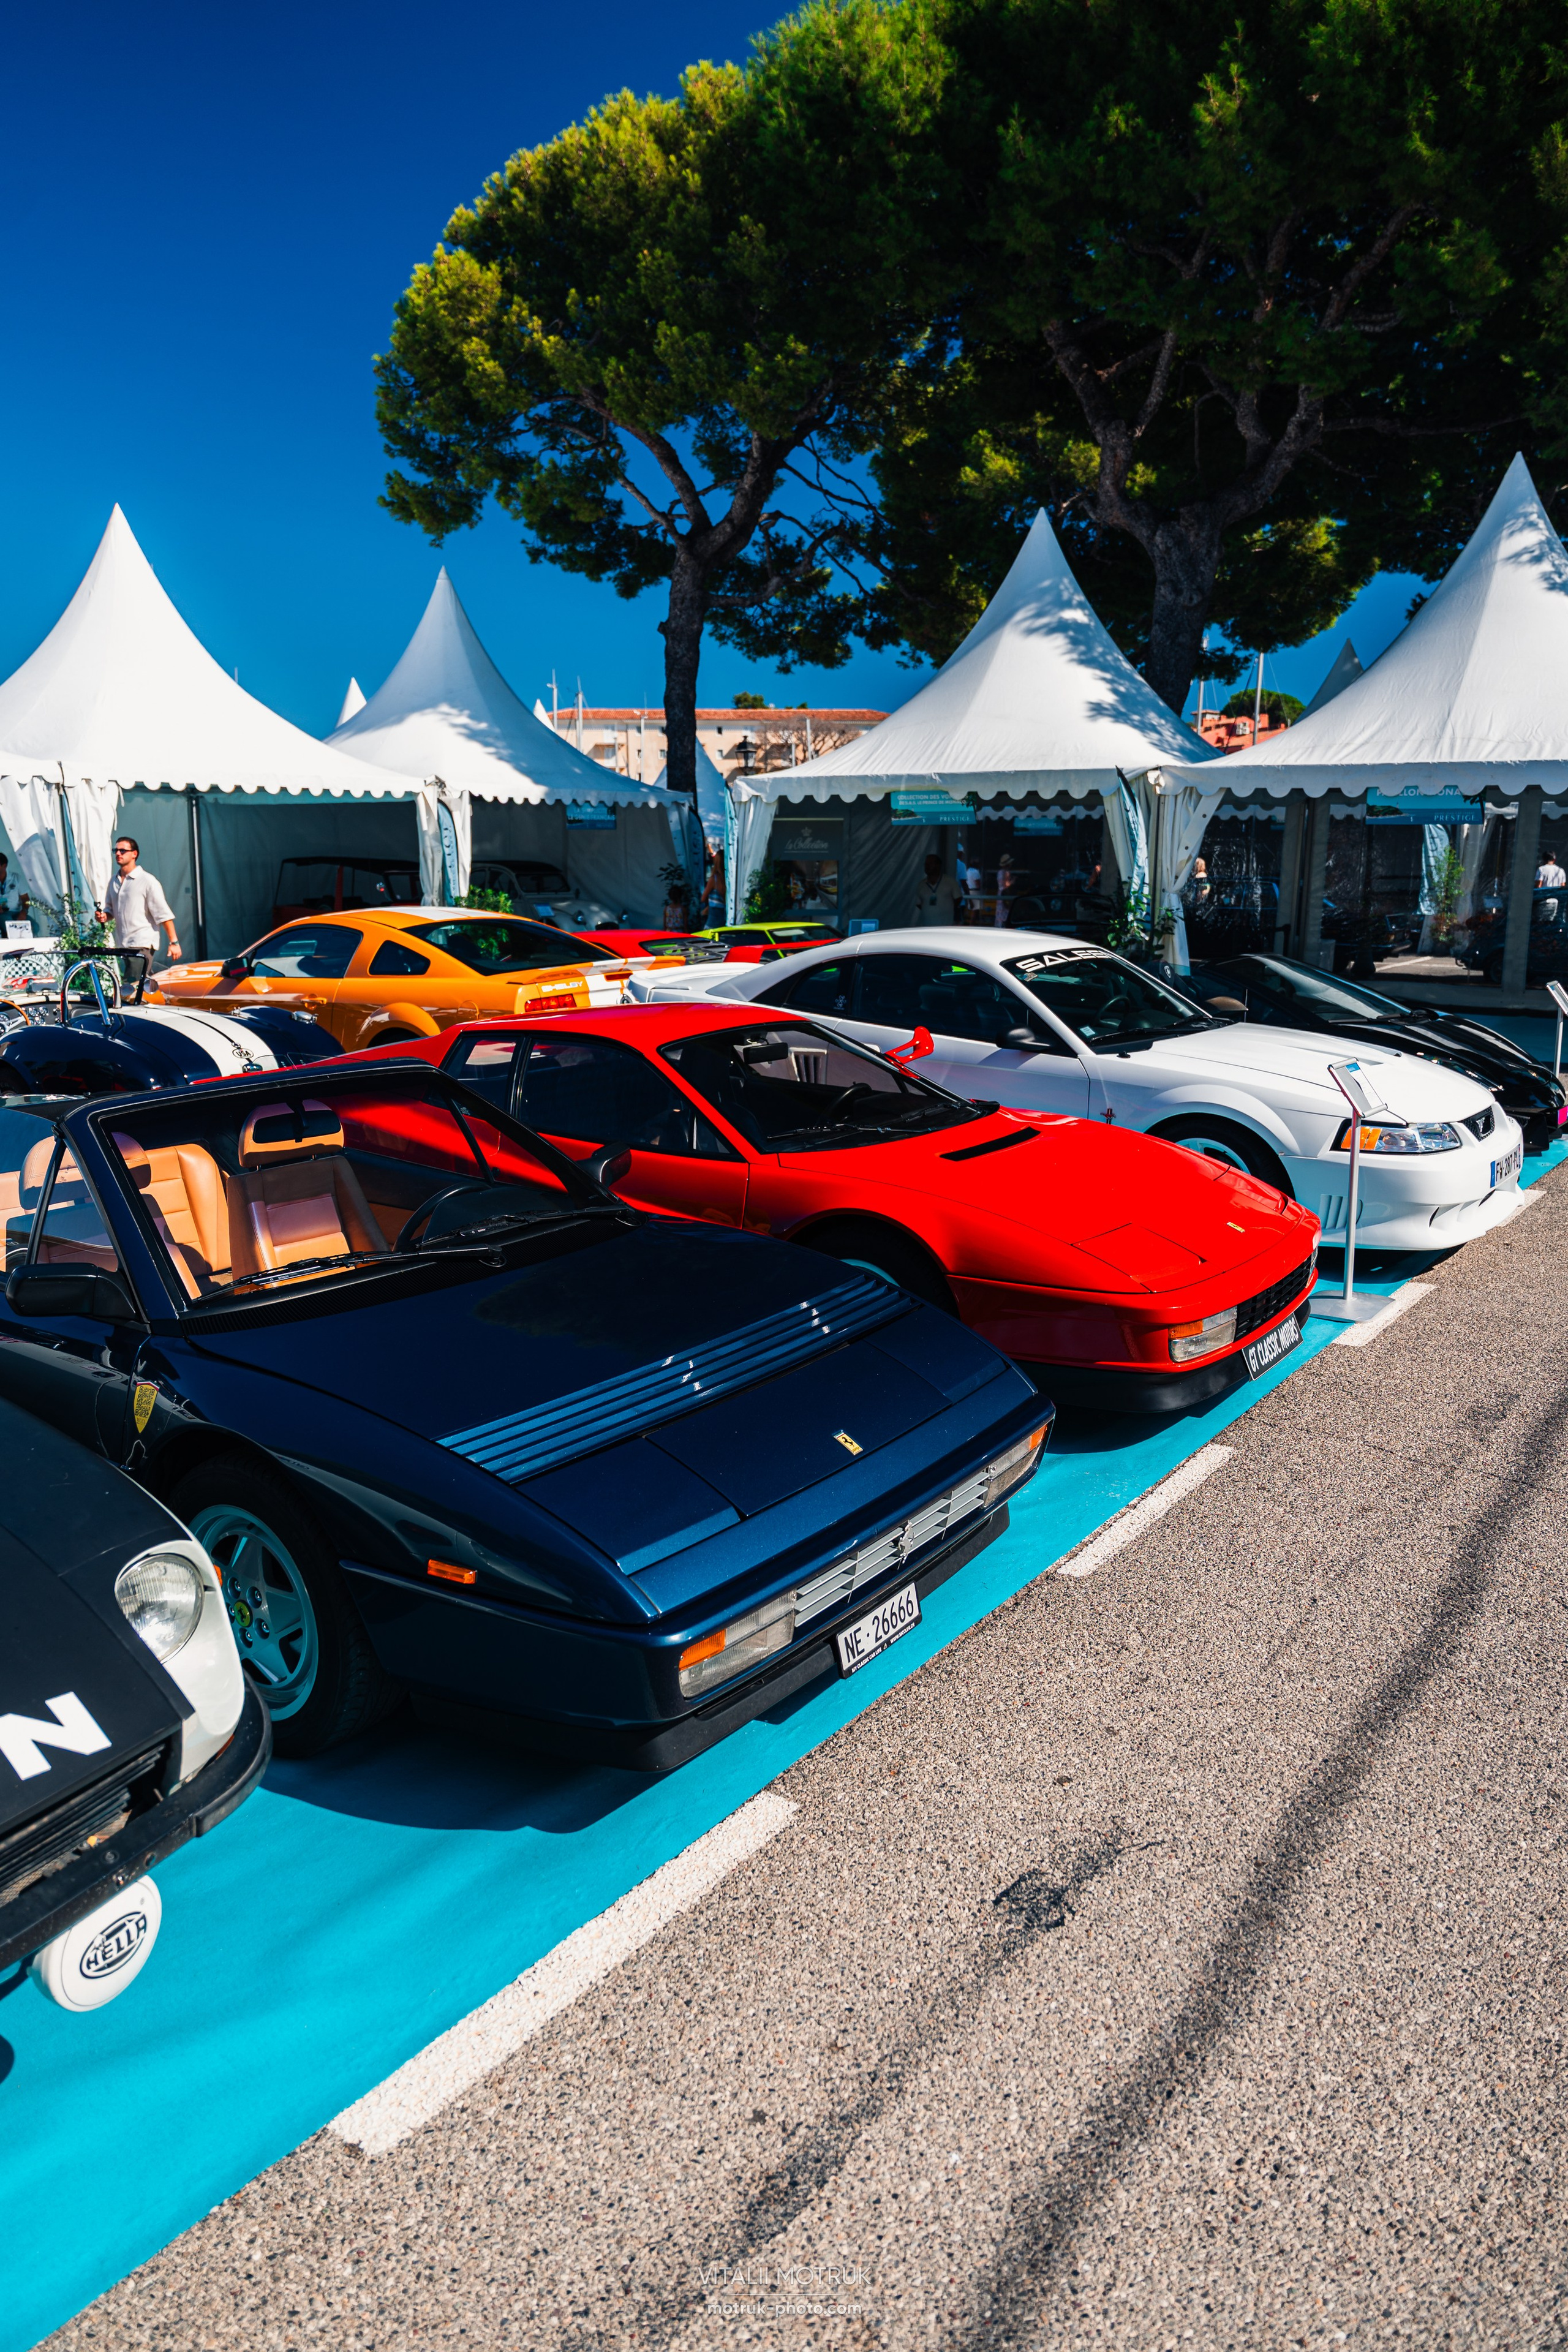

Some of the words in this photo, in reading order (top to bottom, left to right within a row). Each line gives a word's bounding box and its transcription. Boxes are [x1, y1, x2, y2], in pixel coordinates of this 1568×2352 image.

[541, 981, 583, 993] SHELBY
[1249, 1346, 1259, 1373] GT
[1257, 1331, 1282, 1366] CLASSIC
[1277, 1317, 1299, 1351] MOTORS
[857, 1656, 870, 1669] CLASSIC
[86, 1912, 148, 1971] HELLA
